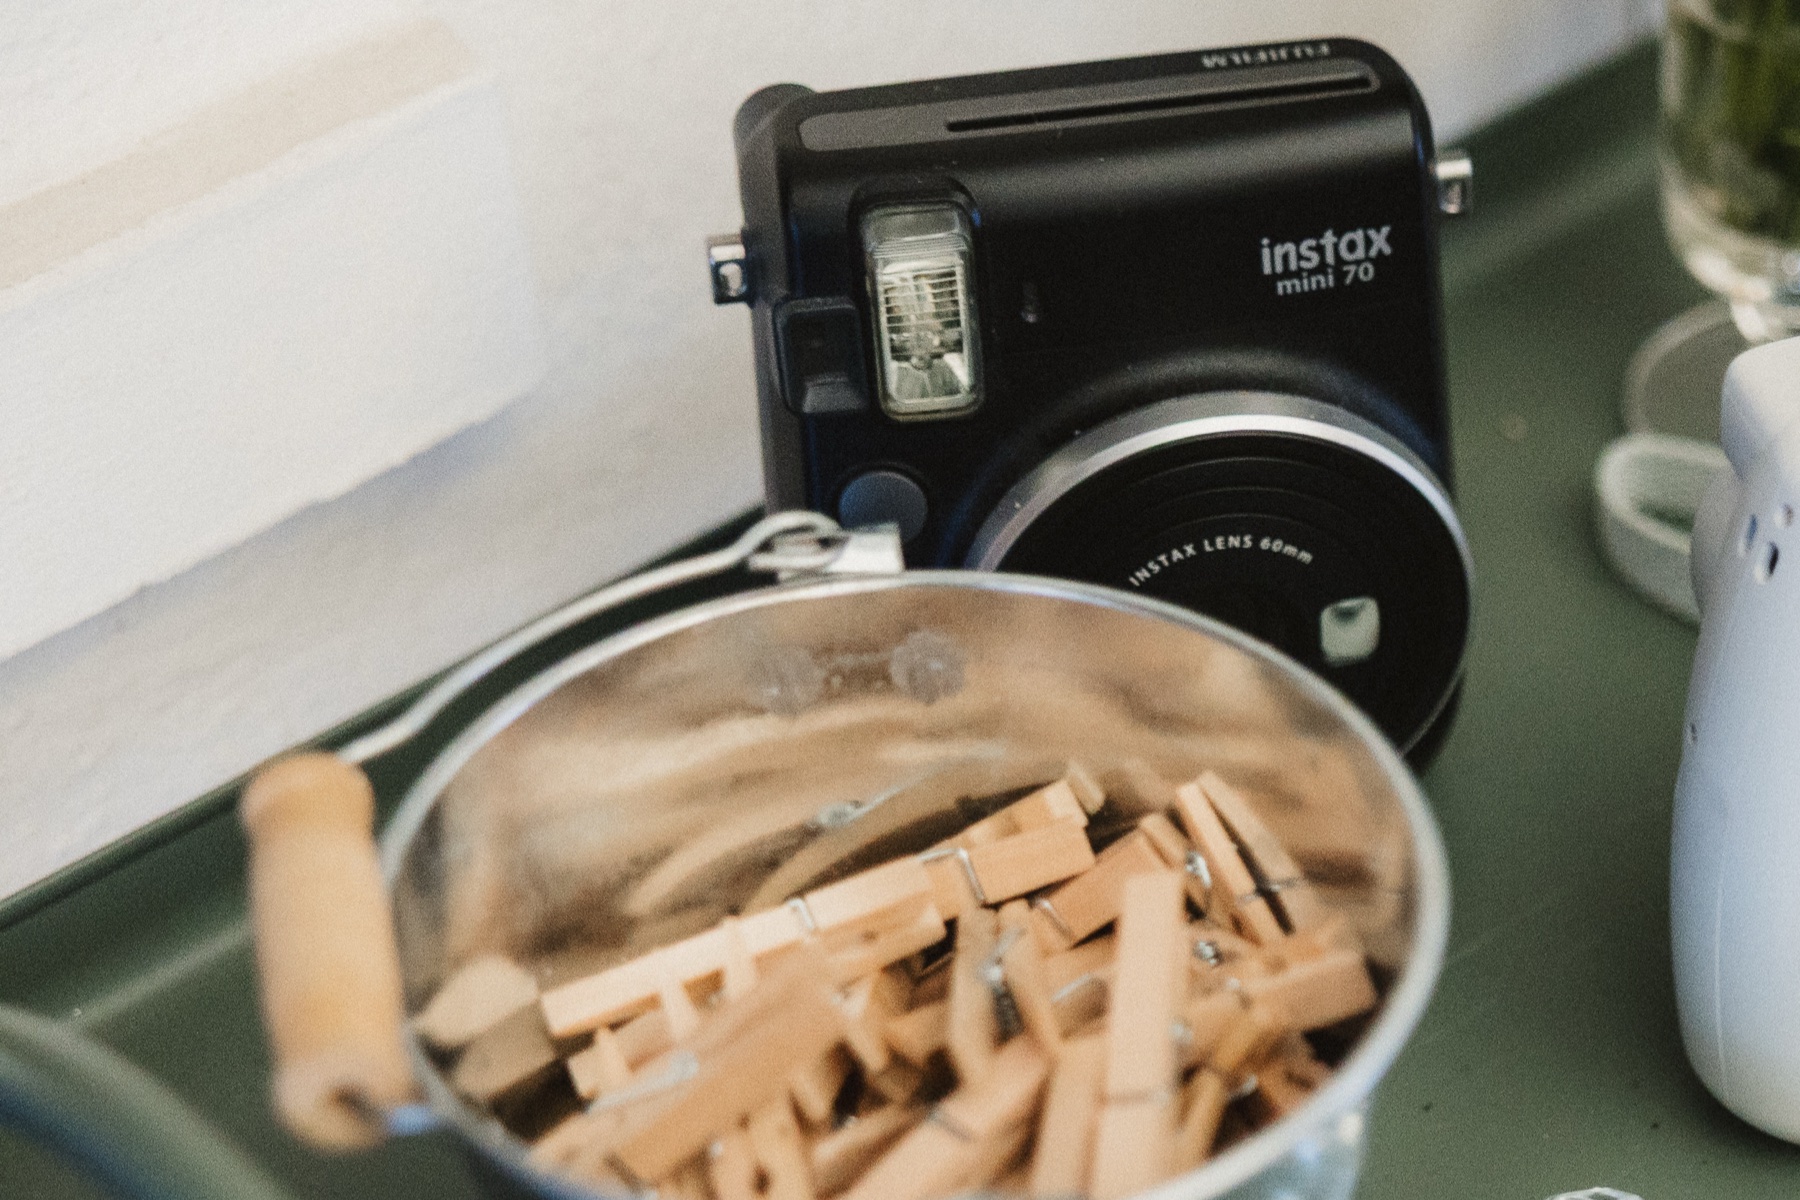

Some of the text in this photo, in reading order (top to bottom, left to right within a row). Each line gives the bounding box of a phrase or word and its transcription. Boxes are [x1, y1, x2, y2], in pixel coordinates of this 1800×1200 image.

[1260, 225, 1392, 276] instax
[1276, 261, 1376, 296] mini 70
[1128, 534, 1313, 587] INSTAX LENS 60mm
